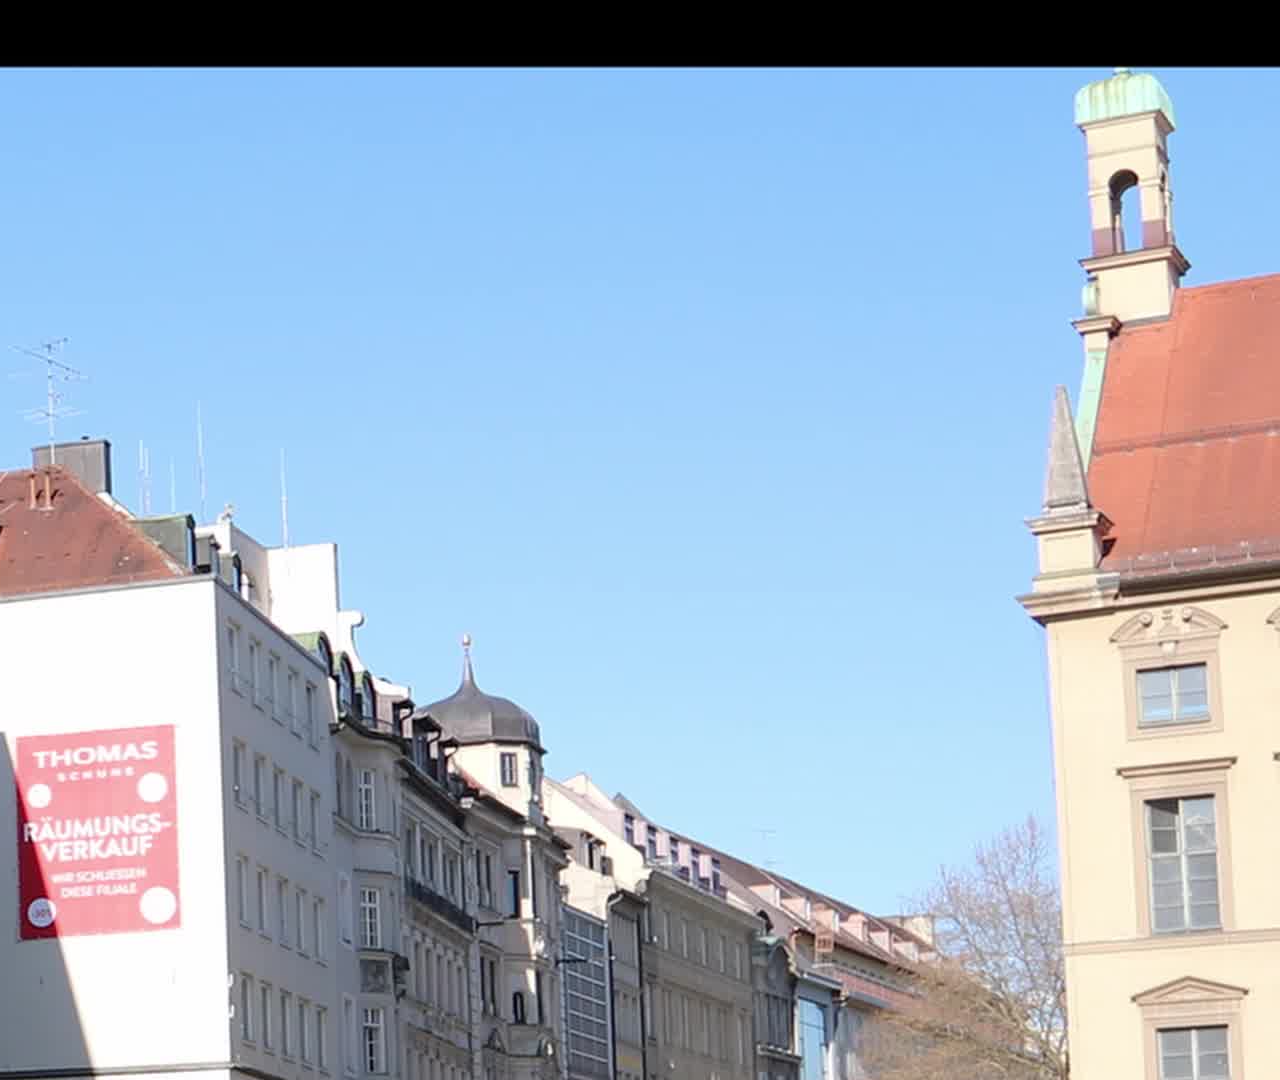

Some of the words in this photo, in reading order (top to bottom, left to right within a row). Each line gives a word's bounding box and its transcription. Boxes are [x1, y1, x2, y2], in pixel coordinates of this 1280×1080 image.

[32, 741, 159, 768] THOMAS
[57, 767, 135, 782] SCHUHE
[24, 813, 172, 842] RÄUMUNGS-
[41, 836, 153, 862] VERKAUF
